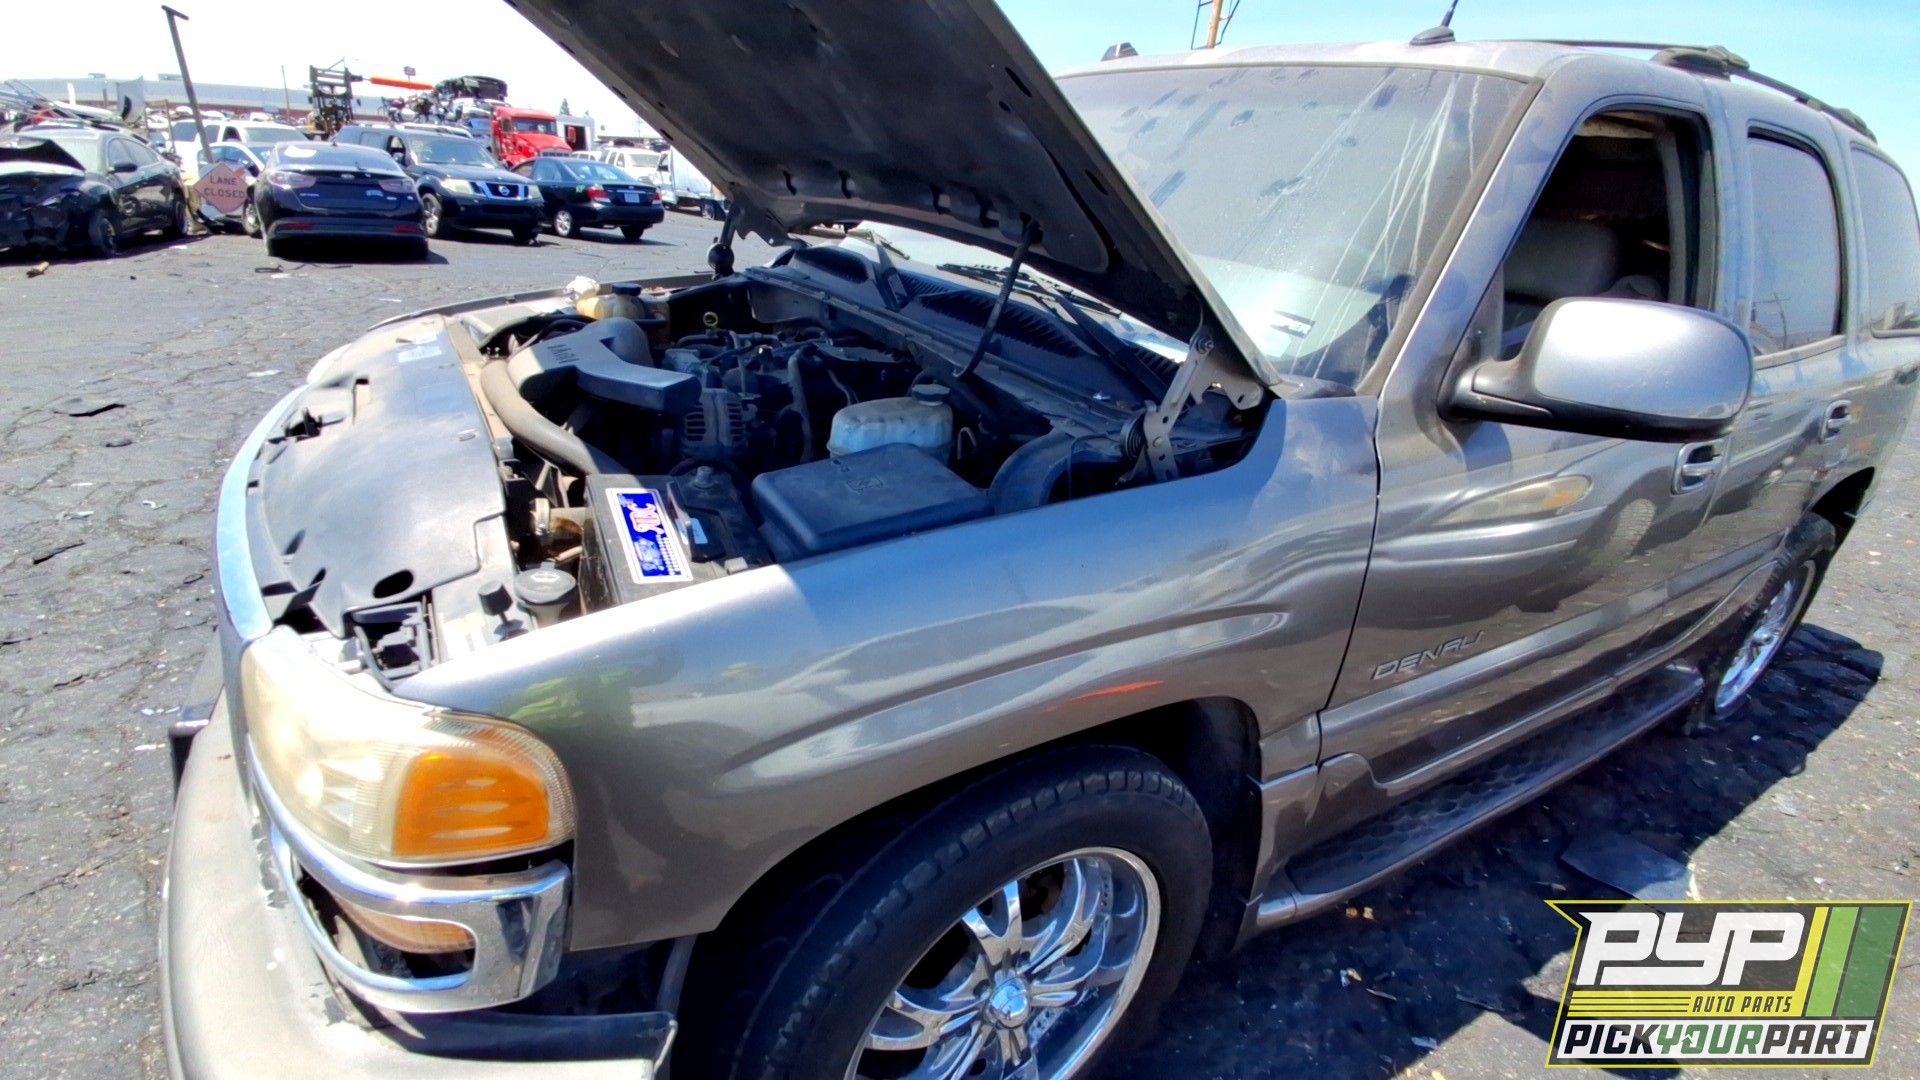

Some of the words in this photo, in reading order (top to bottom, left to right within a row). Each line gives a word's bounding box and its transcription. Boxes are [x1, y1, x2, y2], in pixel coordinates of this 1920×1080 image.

[210, 175, 238, 185] LANE
[203, 187, 246, 199] CLOSED
[1370, 629, 1485, 680] DENALI
